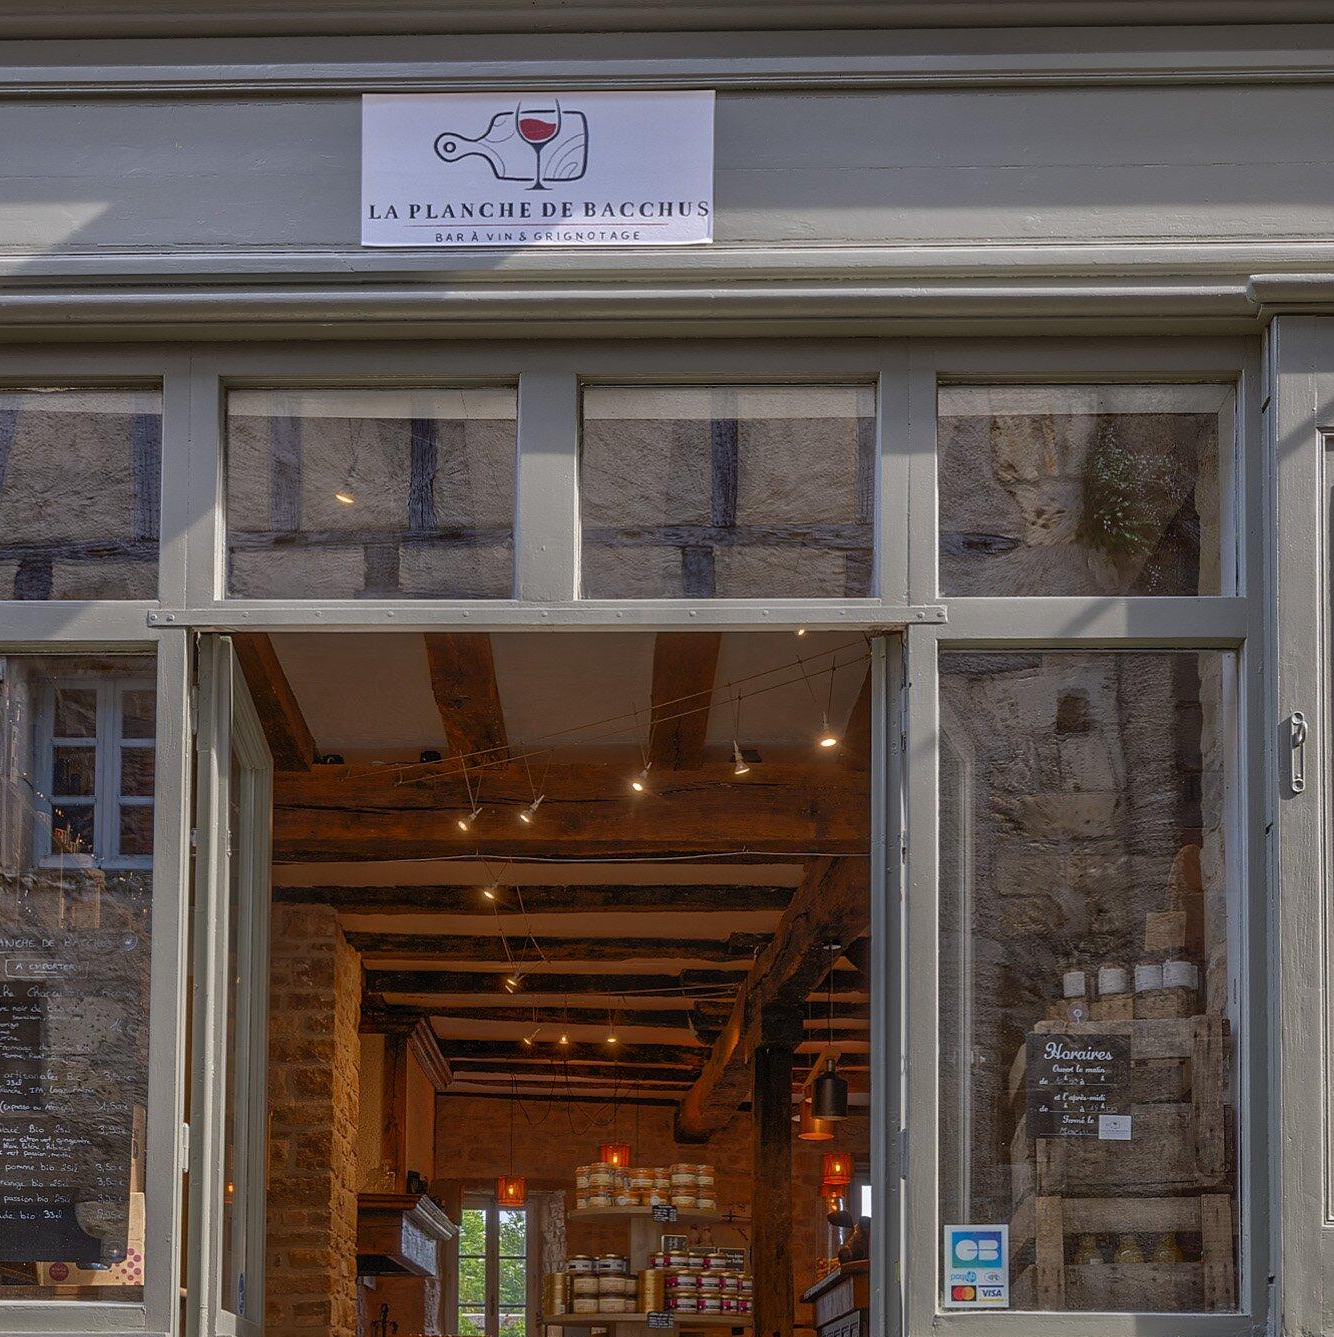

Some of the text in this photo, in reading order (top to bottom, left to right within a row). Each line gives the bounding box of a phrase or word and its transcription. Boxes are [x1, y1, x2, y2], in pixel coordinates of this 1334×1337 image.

[368, 200, 710, 220] LA PLANCHE DE BACCHUS
[435, 229, 641, 242] BAR À VIN & GRIGNOTAGE
[42, 939, 55, 947] DE
[1044, 1041, 1113, 1060] Horaires
[1052, 1064, 1074, 1073] Ouvert
[1076, 1065, 1083, 1073] le
[40, 1163, 54, 1171] bio
[31, 1179, 43, 1188] bio
[37, 1194, 49, 1203] bio
[21, 1210, 36, 1219] bio
